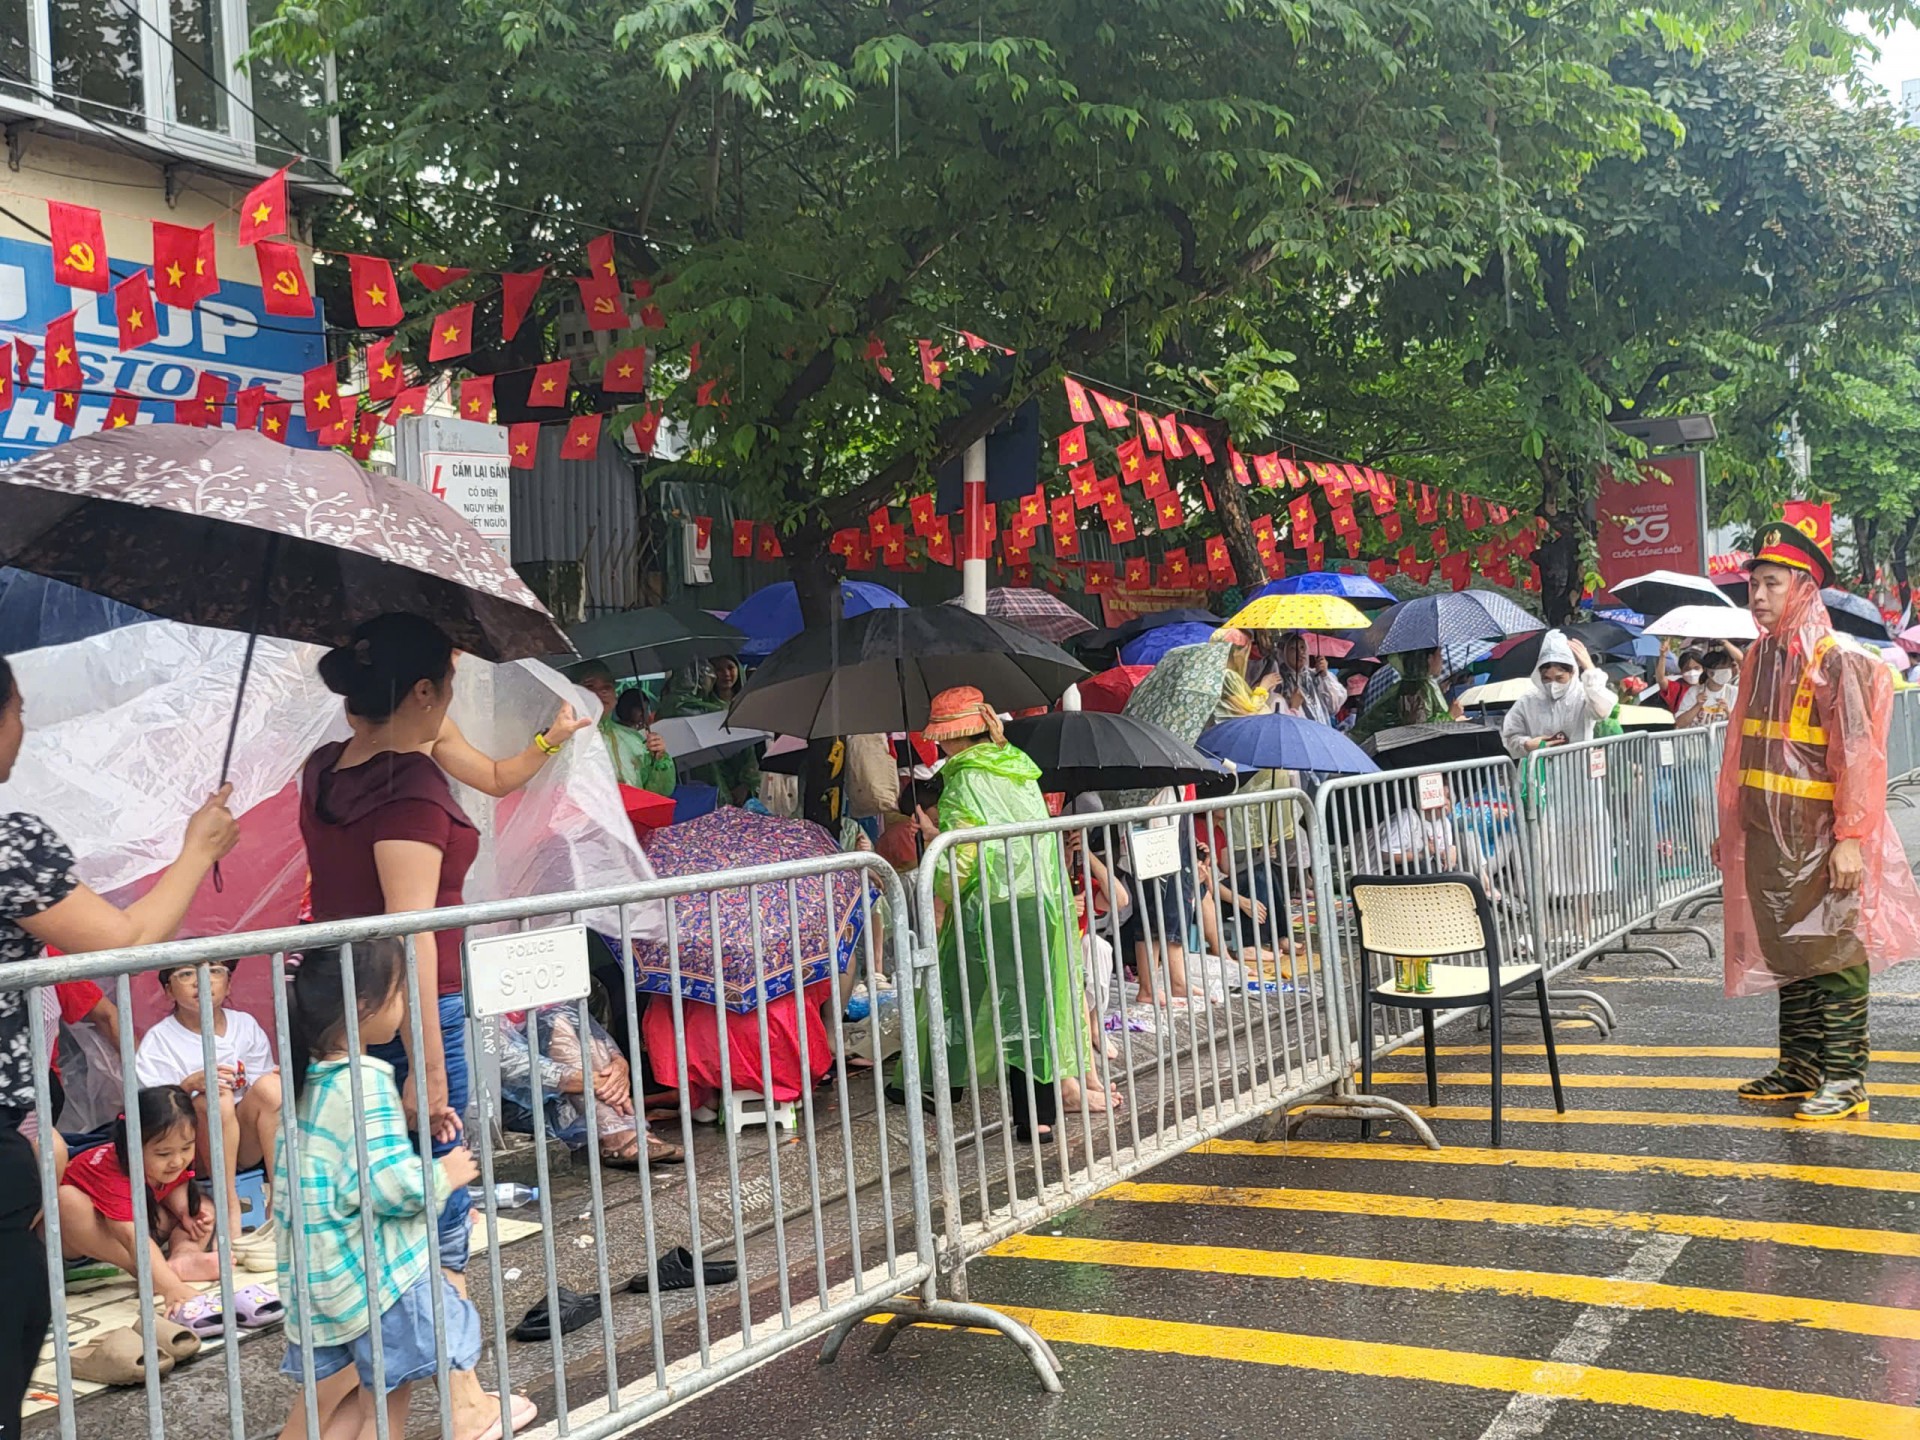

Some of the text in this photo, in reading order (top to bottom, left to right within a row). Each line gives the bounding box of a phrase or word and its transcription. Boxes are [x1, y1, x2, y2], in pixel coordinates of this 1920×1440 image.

[474, 464, 488, 481] LẠI
[463, 503, 485, 513] NGUY
[469, 515, 482, 528] HẾT
[1622, 513, 1670, 546] 5G
[506, 938, 555, 959] POLICE
[499, 961, 566, 997] STOP
